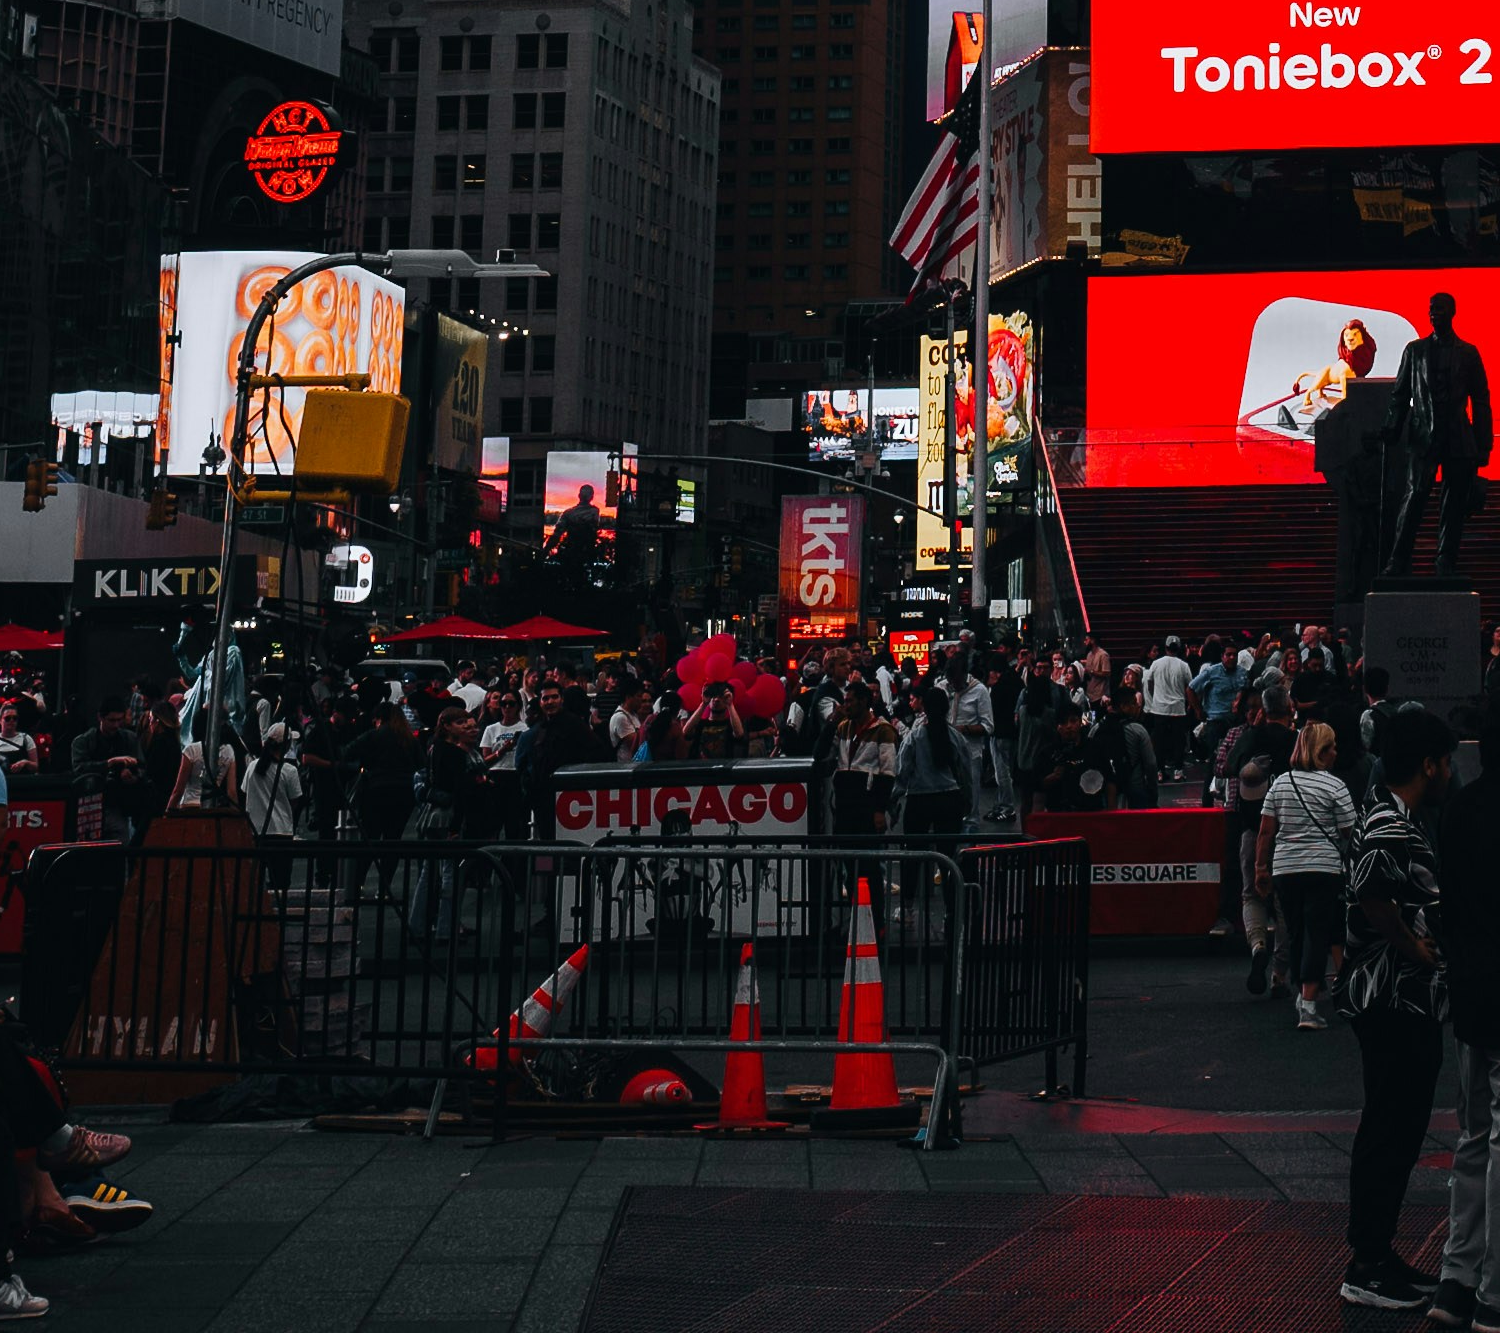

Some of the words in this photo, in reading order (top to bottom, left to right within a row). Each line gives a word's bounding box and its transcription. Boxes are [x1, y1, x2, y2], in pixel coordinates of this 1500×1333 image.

[1289, 2, 1361, 28] New
[1459, 38, 1492, 85] 2
[271, 109, 315, 131] HOT
[248, 159, 294, 171] ORIGINAL
[268, 170, 313, 195] NOW
[800, 503, 849, 607] tkts
[1396, 636, 1449, 649] GEORGE
[1400, 661, 1446, 673] COHAN
[556, 782, 808, 831] CHICAGO
[1120, 864, 1198, 883] SQUARE
